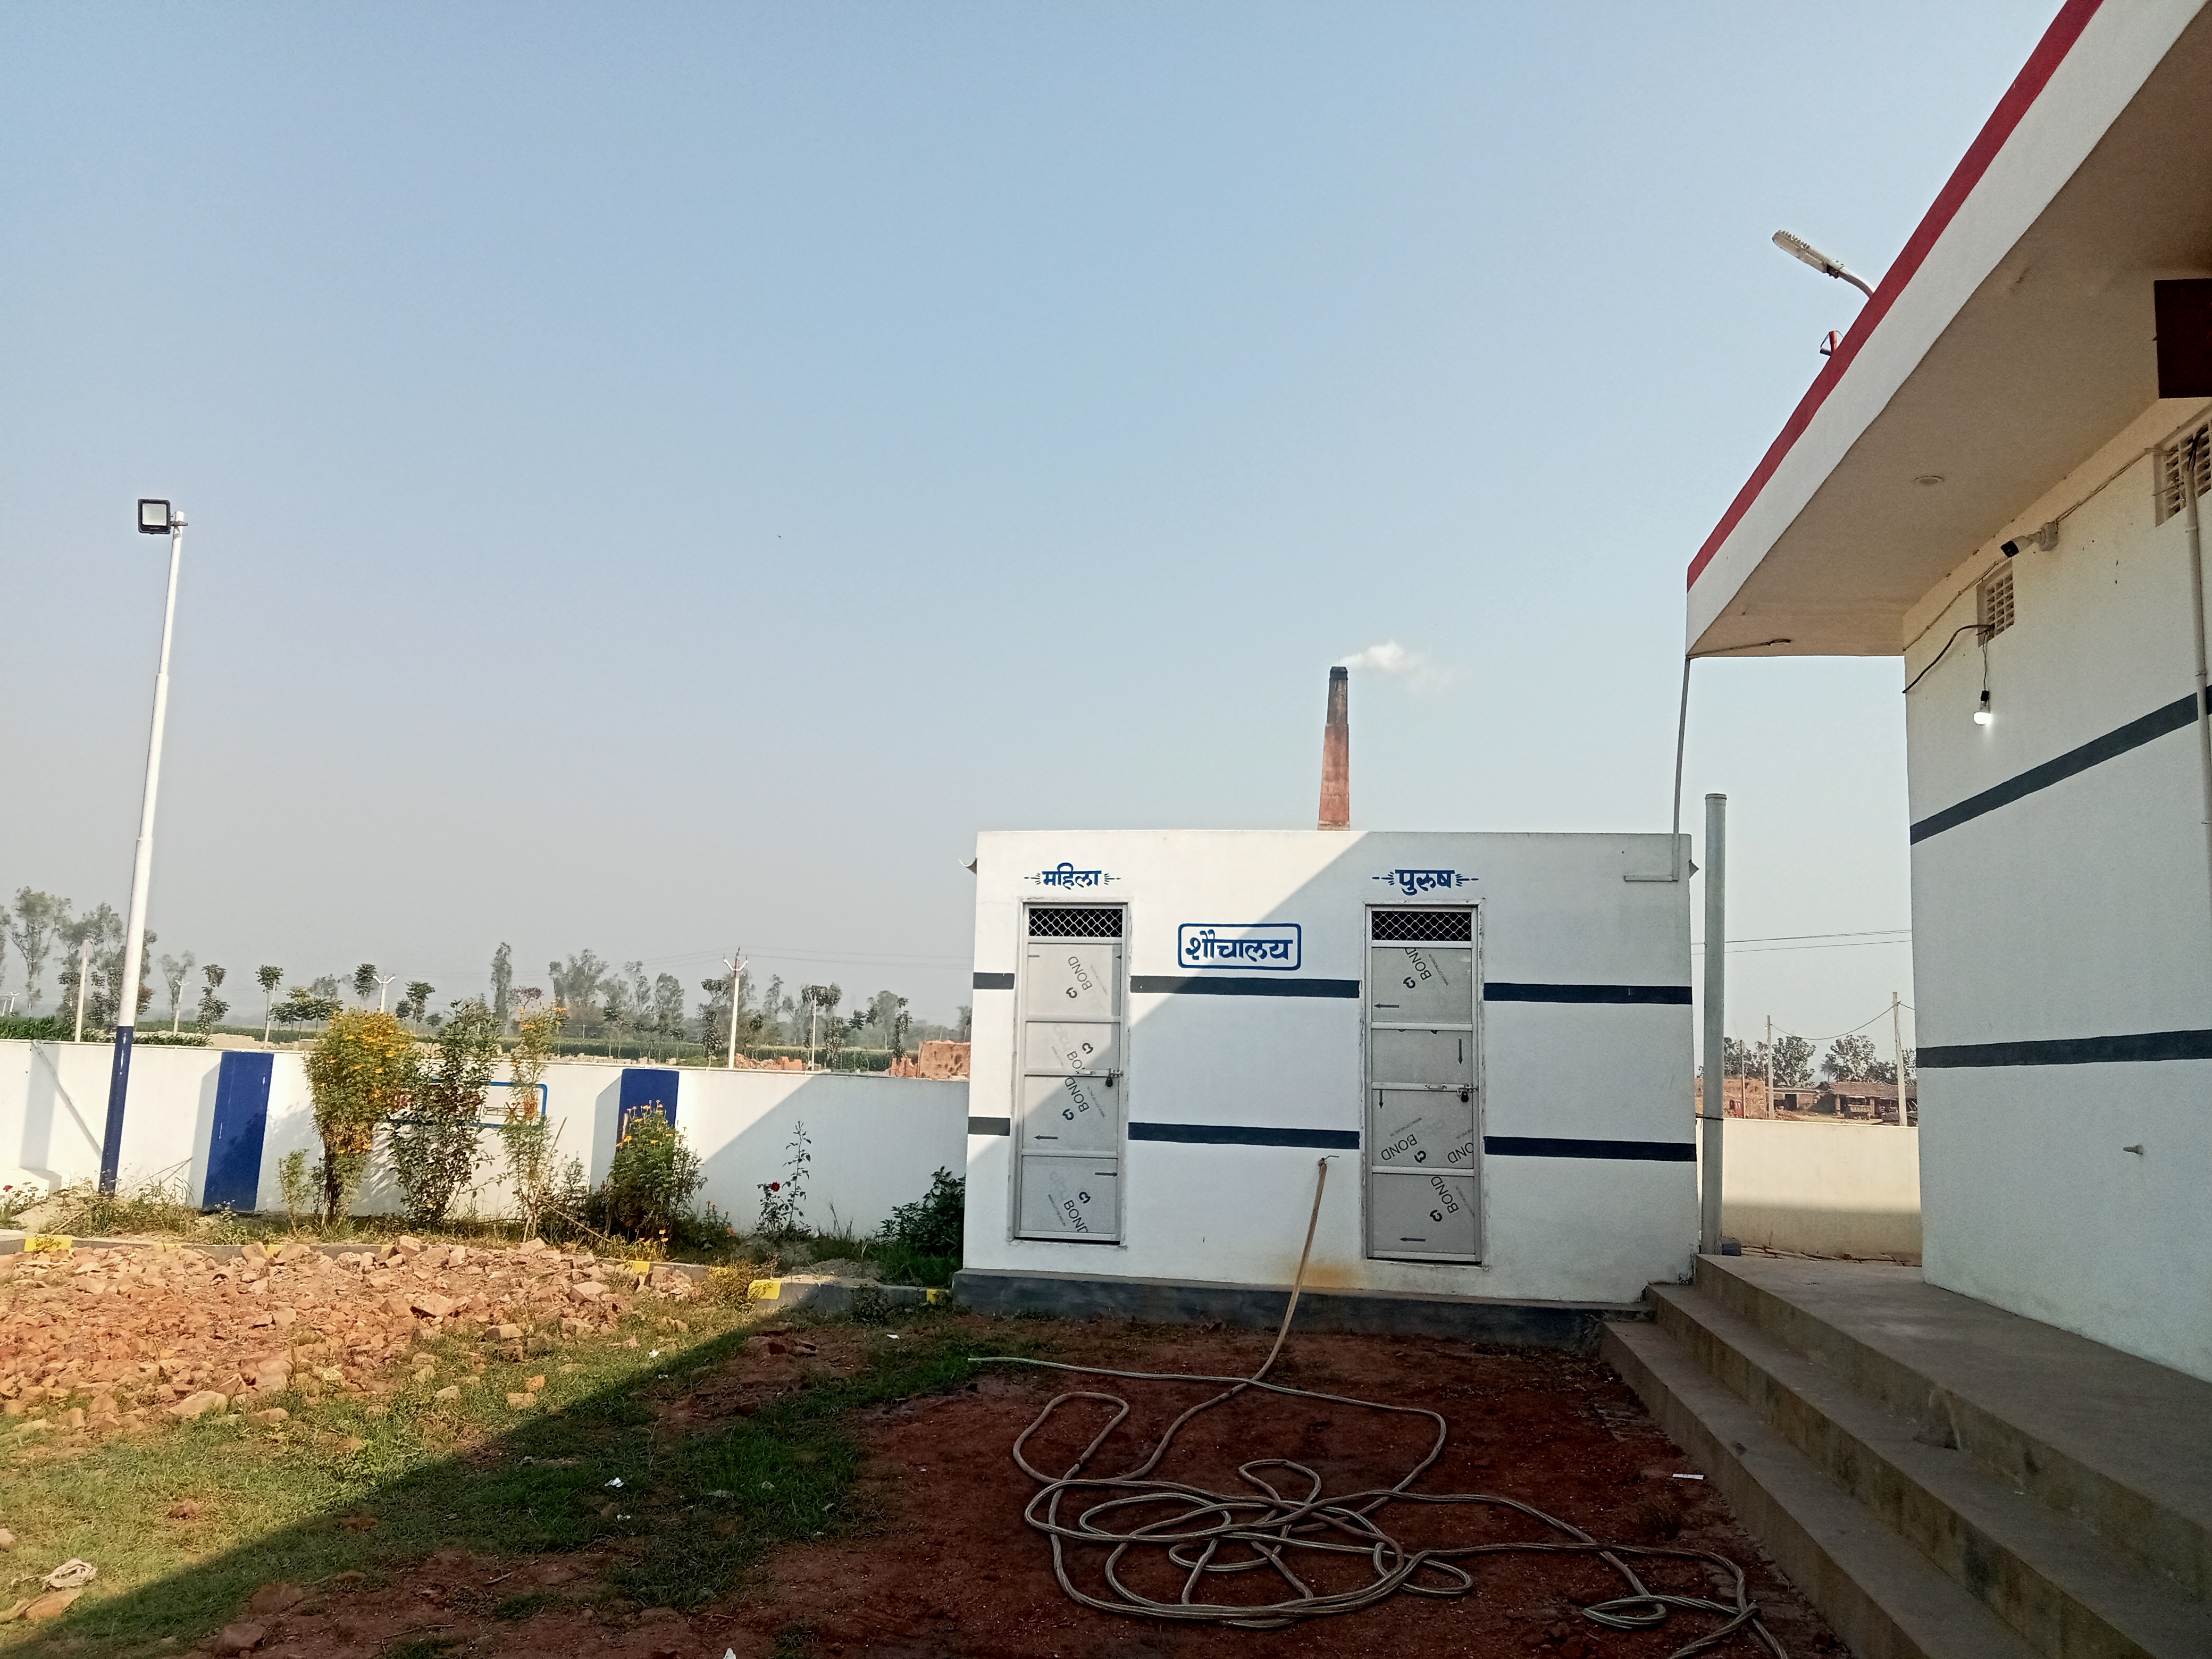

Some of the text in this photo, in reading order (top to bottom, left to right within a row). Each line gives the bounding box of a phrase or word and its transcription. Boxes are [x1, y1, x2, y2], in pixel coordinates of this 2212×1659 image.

[1042, 862, 1102, 890] महिला
[1185, 929, 1293, 962] शौचालय
[1068, 956, 1092, 990] BOND
[1065, 1077, 1090, 1112] BOND
[1381, 1134, 1418, 1161] BOND
[1430, 1176, 1459, 1214] BOND
